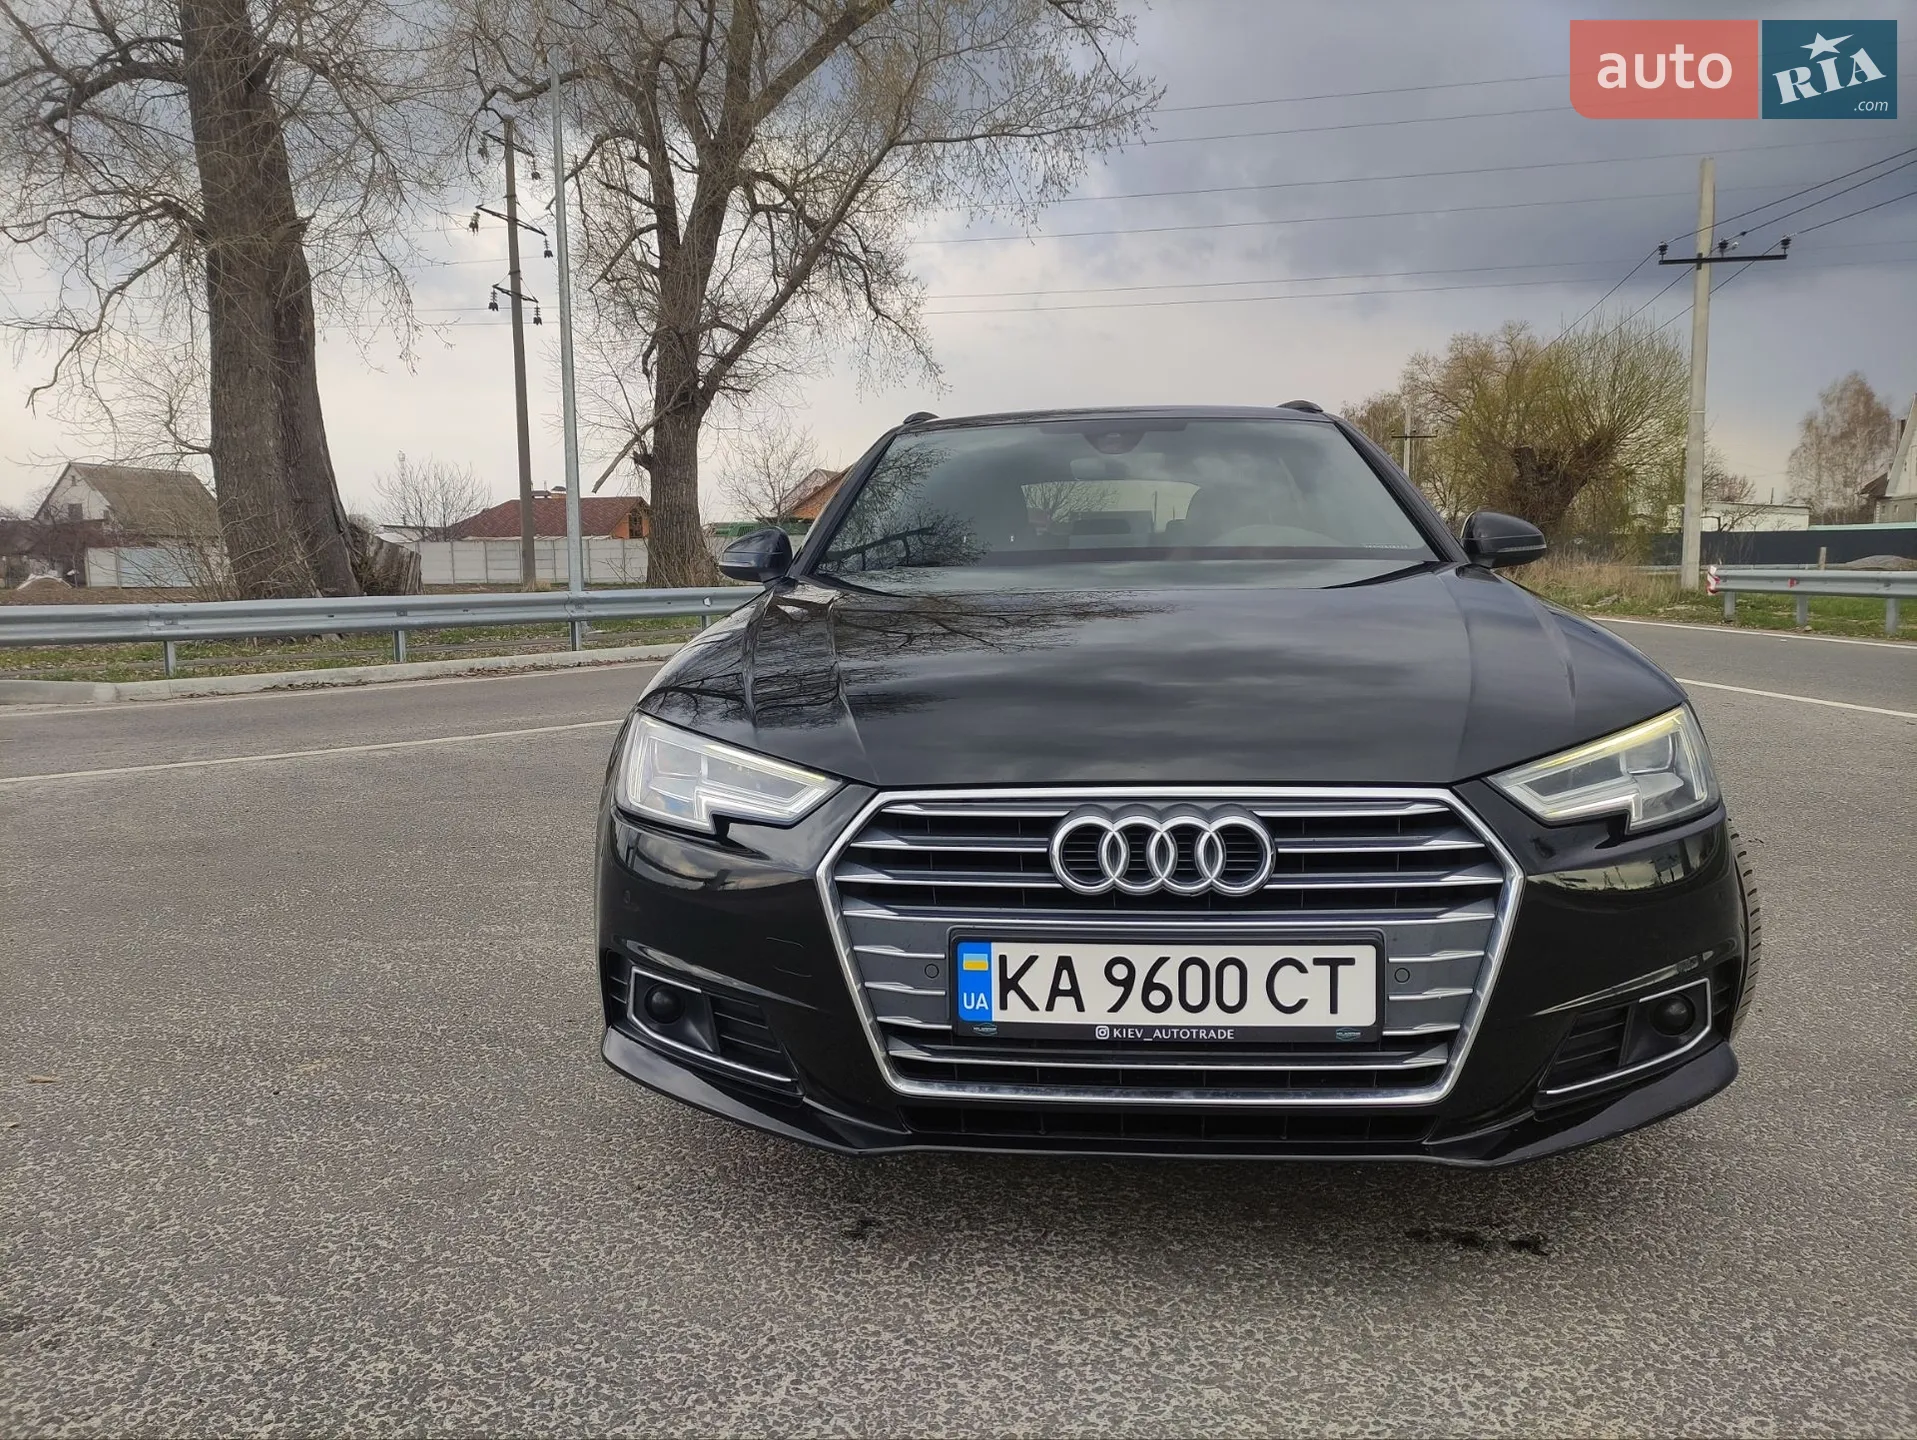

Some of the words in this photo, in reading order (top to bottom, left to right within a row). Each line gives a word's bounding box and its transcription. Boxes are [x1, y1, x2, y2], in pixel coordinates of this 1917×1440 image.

[998, 954, 1086, 1013] KA
[1103, 956, 1248, 1014] 9600
[1265, 957, 1356, 1015] CT
[963, 992, 989, 1010] UA
[1113, 1028, 1235, 1041] KIEV_AUTOTRADE
